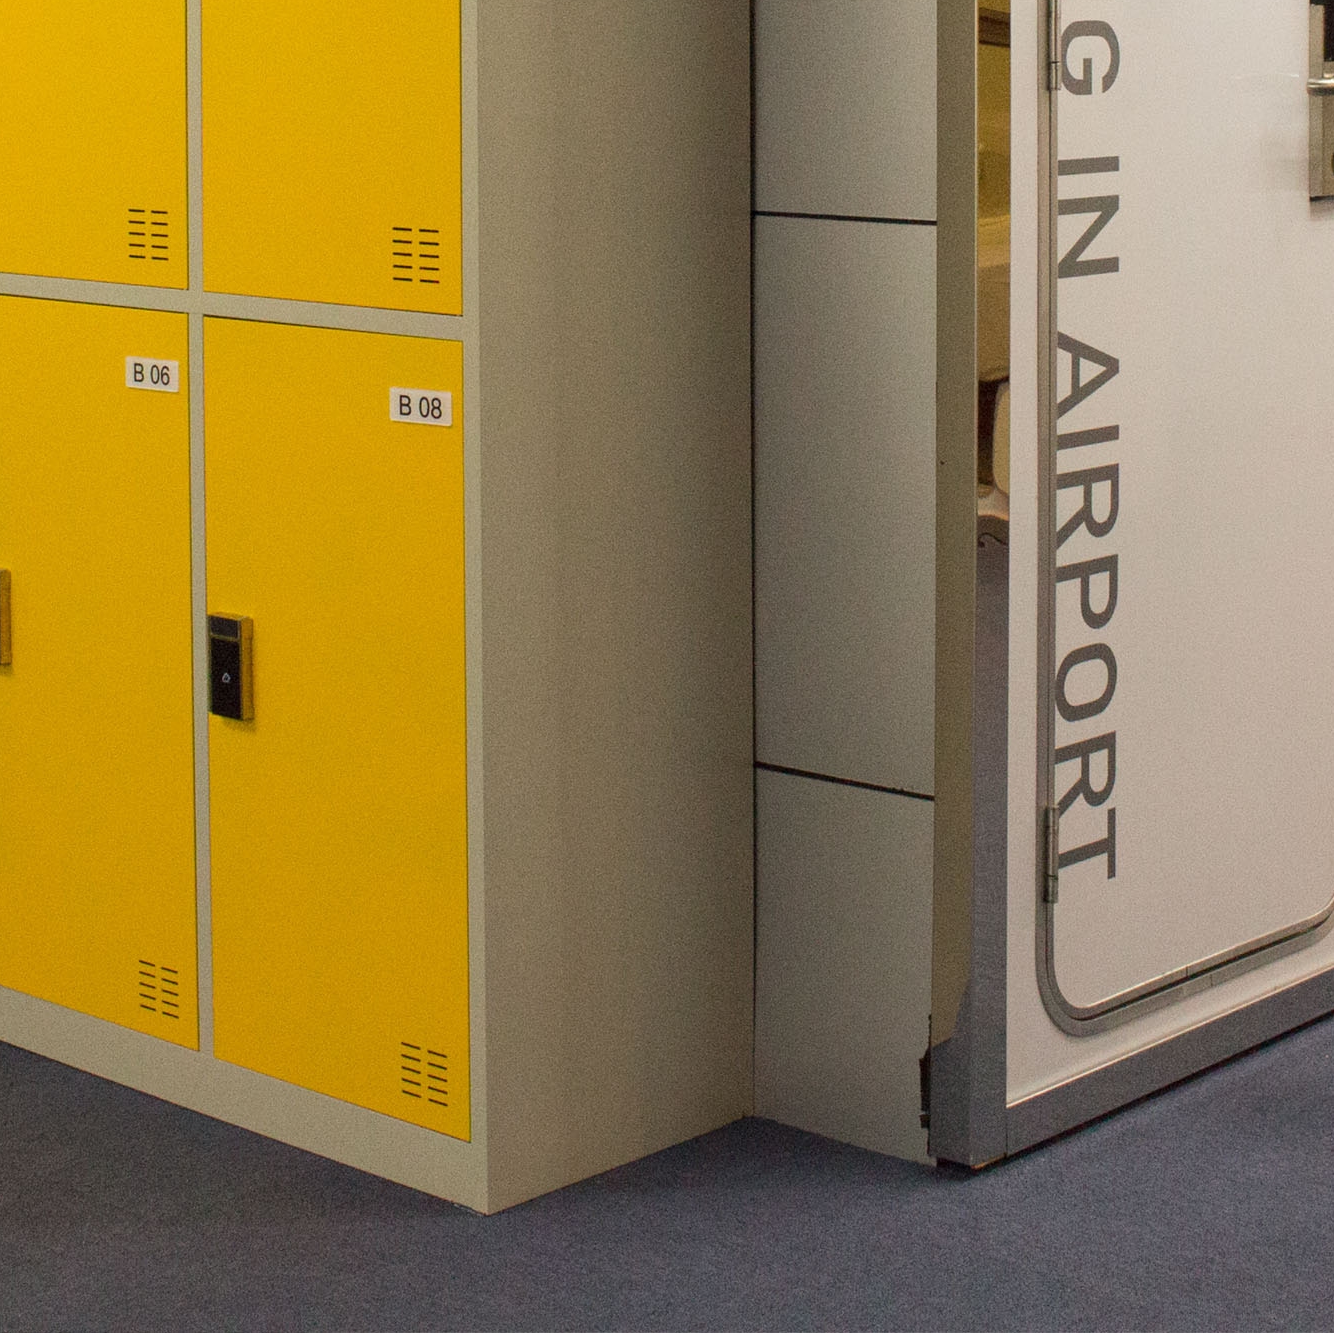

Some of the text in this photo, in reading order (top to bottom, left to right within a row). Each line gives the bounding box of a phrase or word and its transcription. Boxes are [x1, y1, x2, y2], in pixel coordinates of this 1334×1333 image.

[1057, 156, 1120, 279] IN
[133, 362, 170, 386] B 06
[399, 394, 442, 419] B 08
[1055, 330, 1120, 880] AIRPORT
